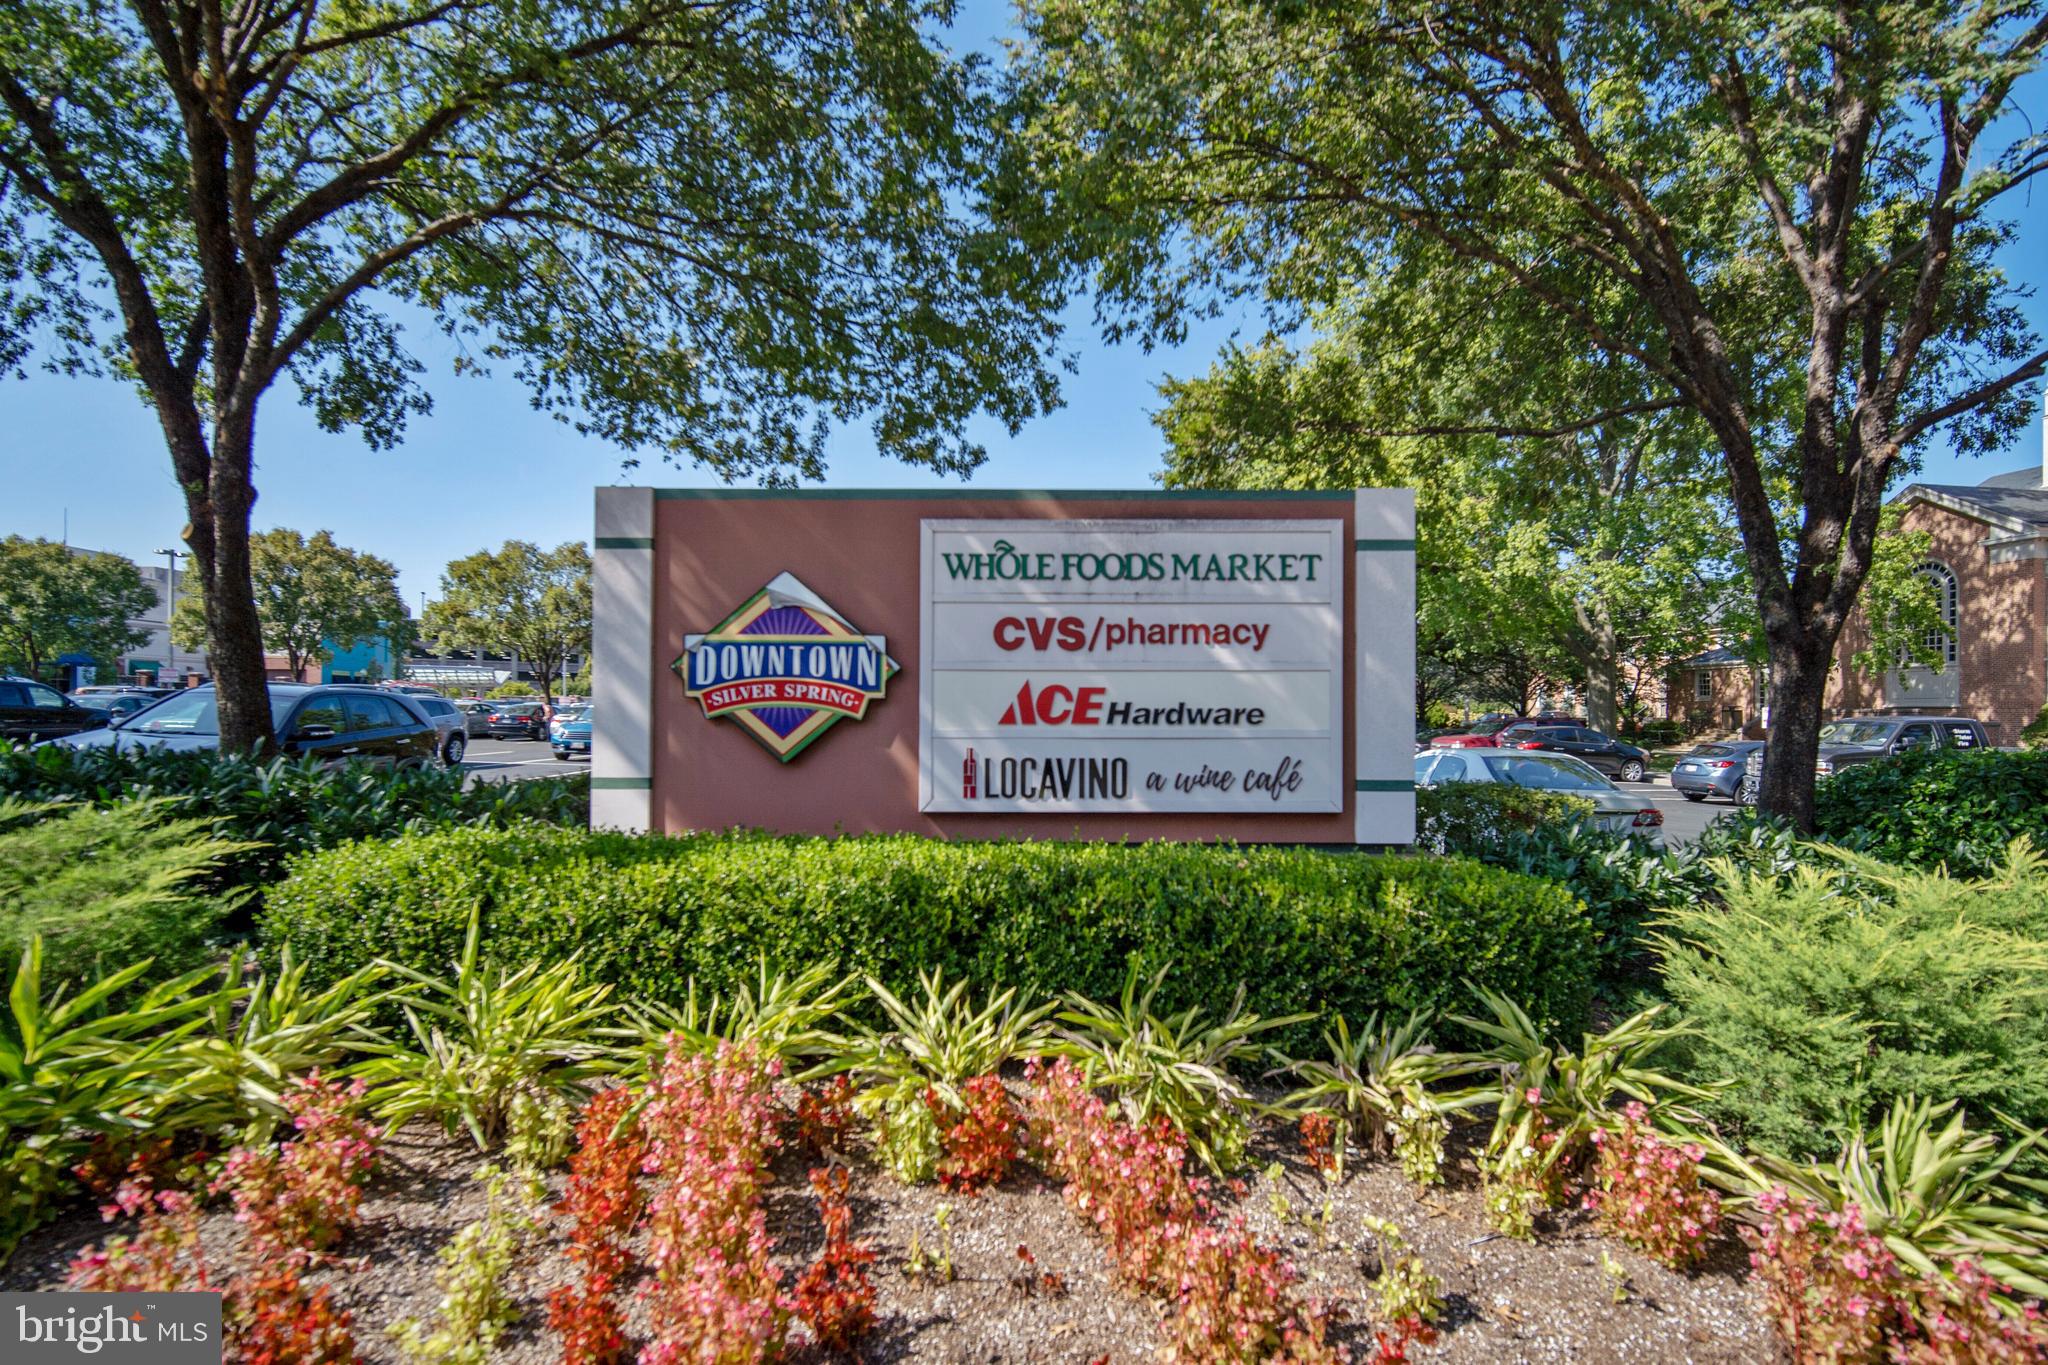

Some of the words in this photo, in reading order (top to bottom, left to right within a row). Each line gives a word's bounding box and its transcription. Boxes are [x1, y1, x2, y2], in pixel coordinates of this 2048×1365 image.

[942, 540, 1056, 581] WHOLE
[1060, 552, 1166, 581] FOODS
[1170, 553, 1323, 582] MARKET
[993, 616, 1270, 652] CVS/pharmacy
[695, 644, 876, 687] DOWNTOWN
[710, 683, 778, 707] SILVER
[783, 683, 855, 708] SPRING
[998, 679, 1107, 725] ACE
[1106, 701, 1266, 725] Hardware
[984, 757, 1128, 799] LOCAVINO
[1145, 771, 1168, 793] a
[1174, 764, 1236, 793] wine
[1243, 755, 1304, 801] café
